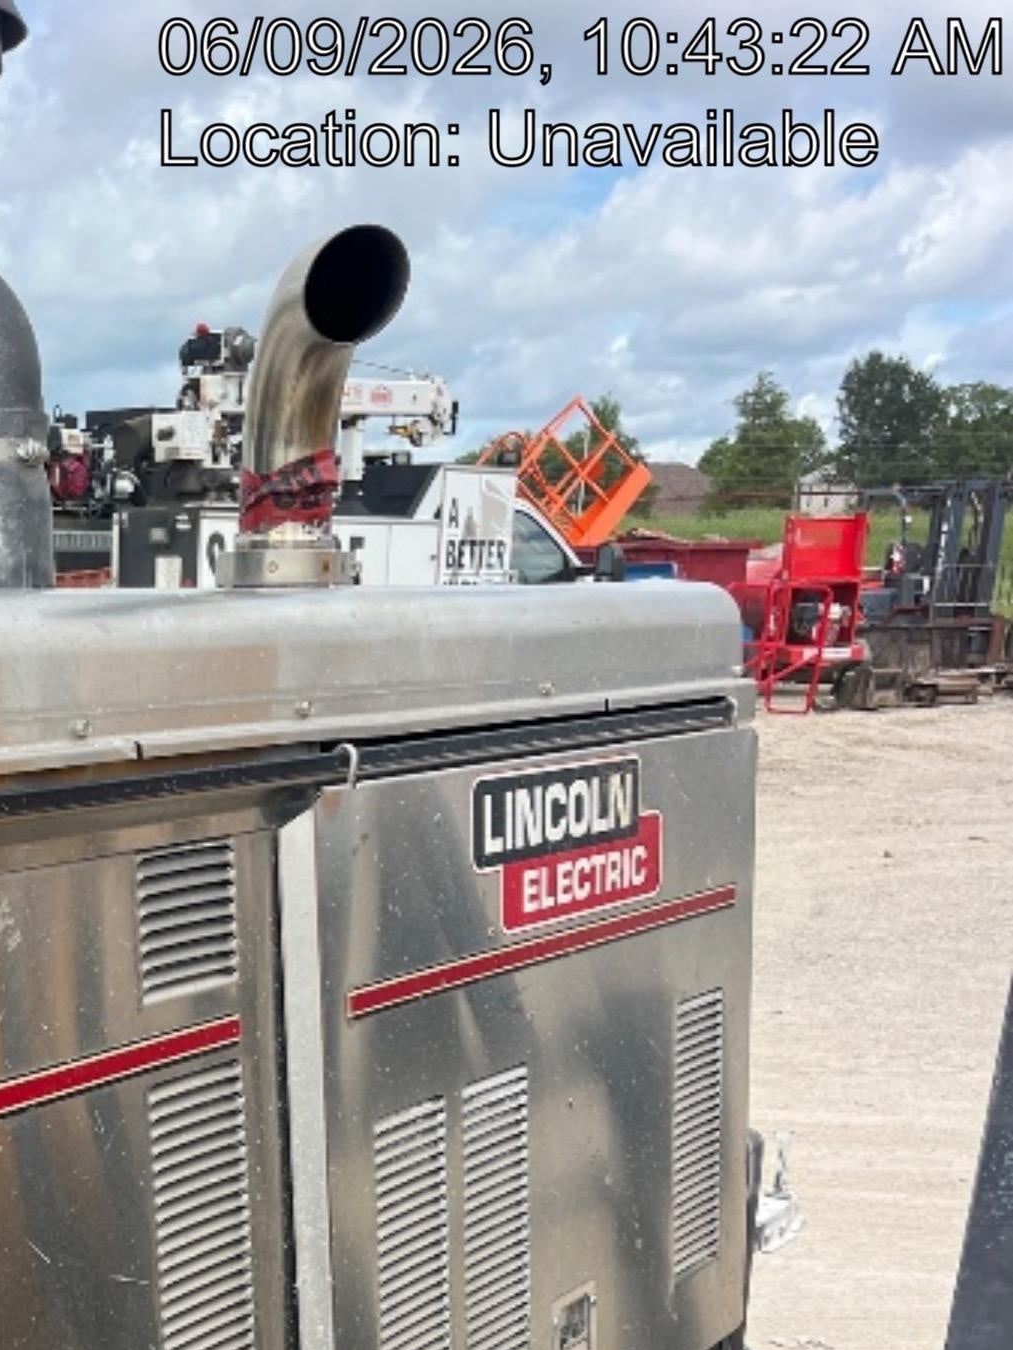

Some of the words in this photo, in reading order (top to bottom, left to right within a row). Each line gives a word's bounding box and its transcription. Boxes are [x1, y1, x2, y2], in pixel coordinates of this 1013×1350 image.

[449, 497, 459, 528] A
[446, 539, 506, 570] BETTER
[484, 773, 633, 856] LINCOLN
[523, 846, 647, 913] ELECTRIC
